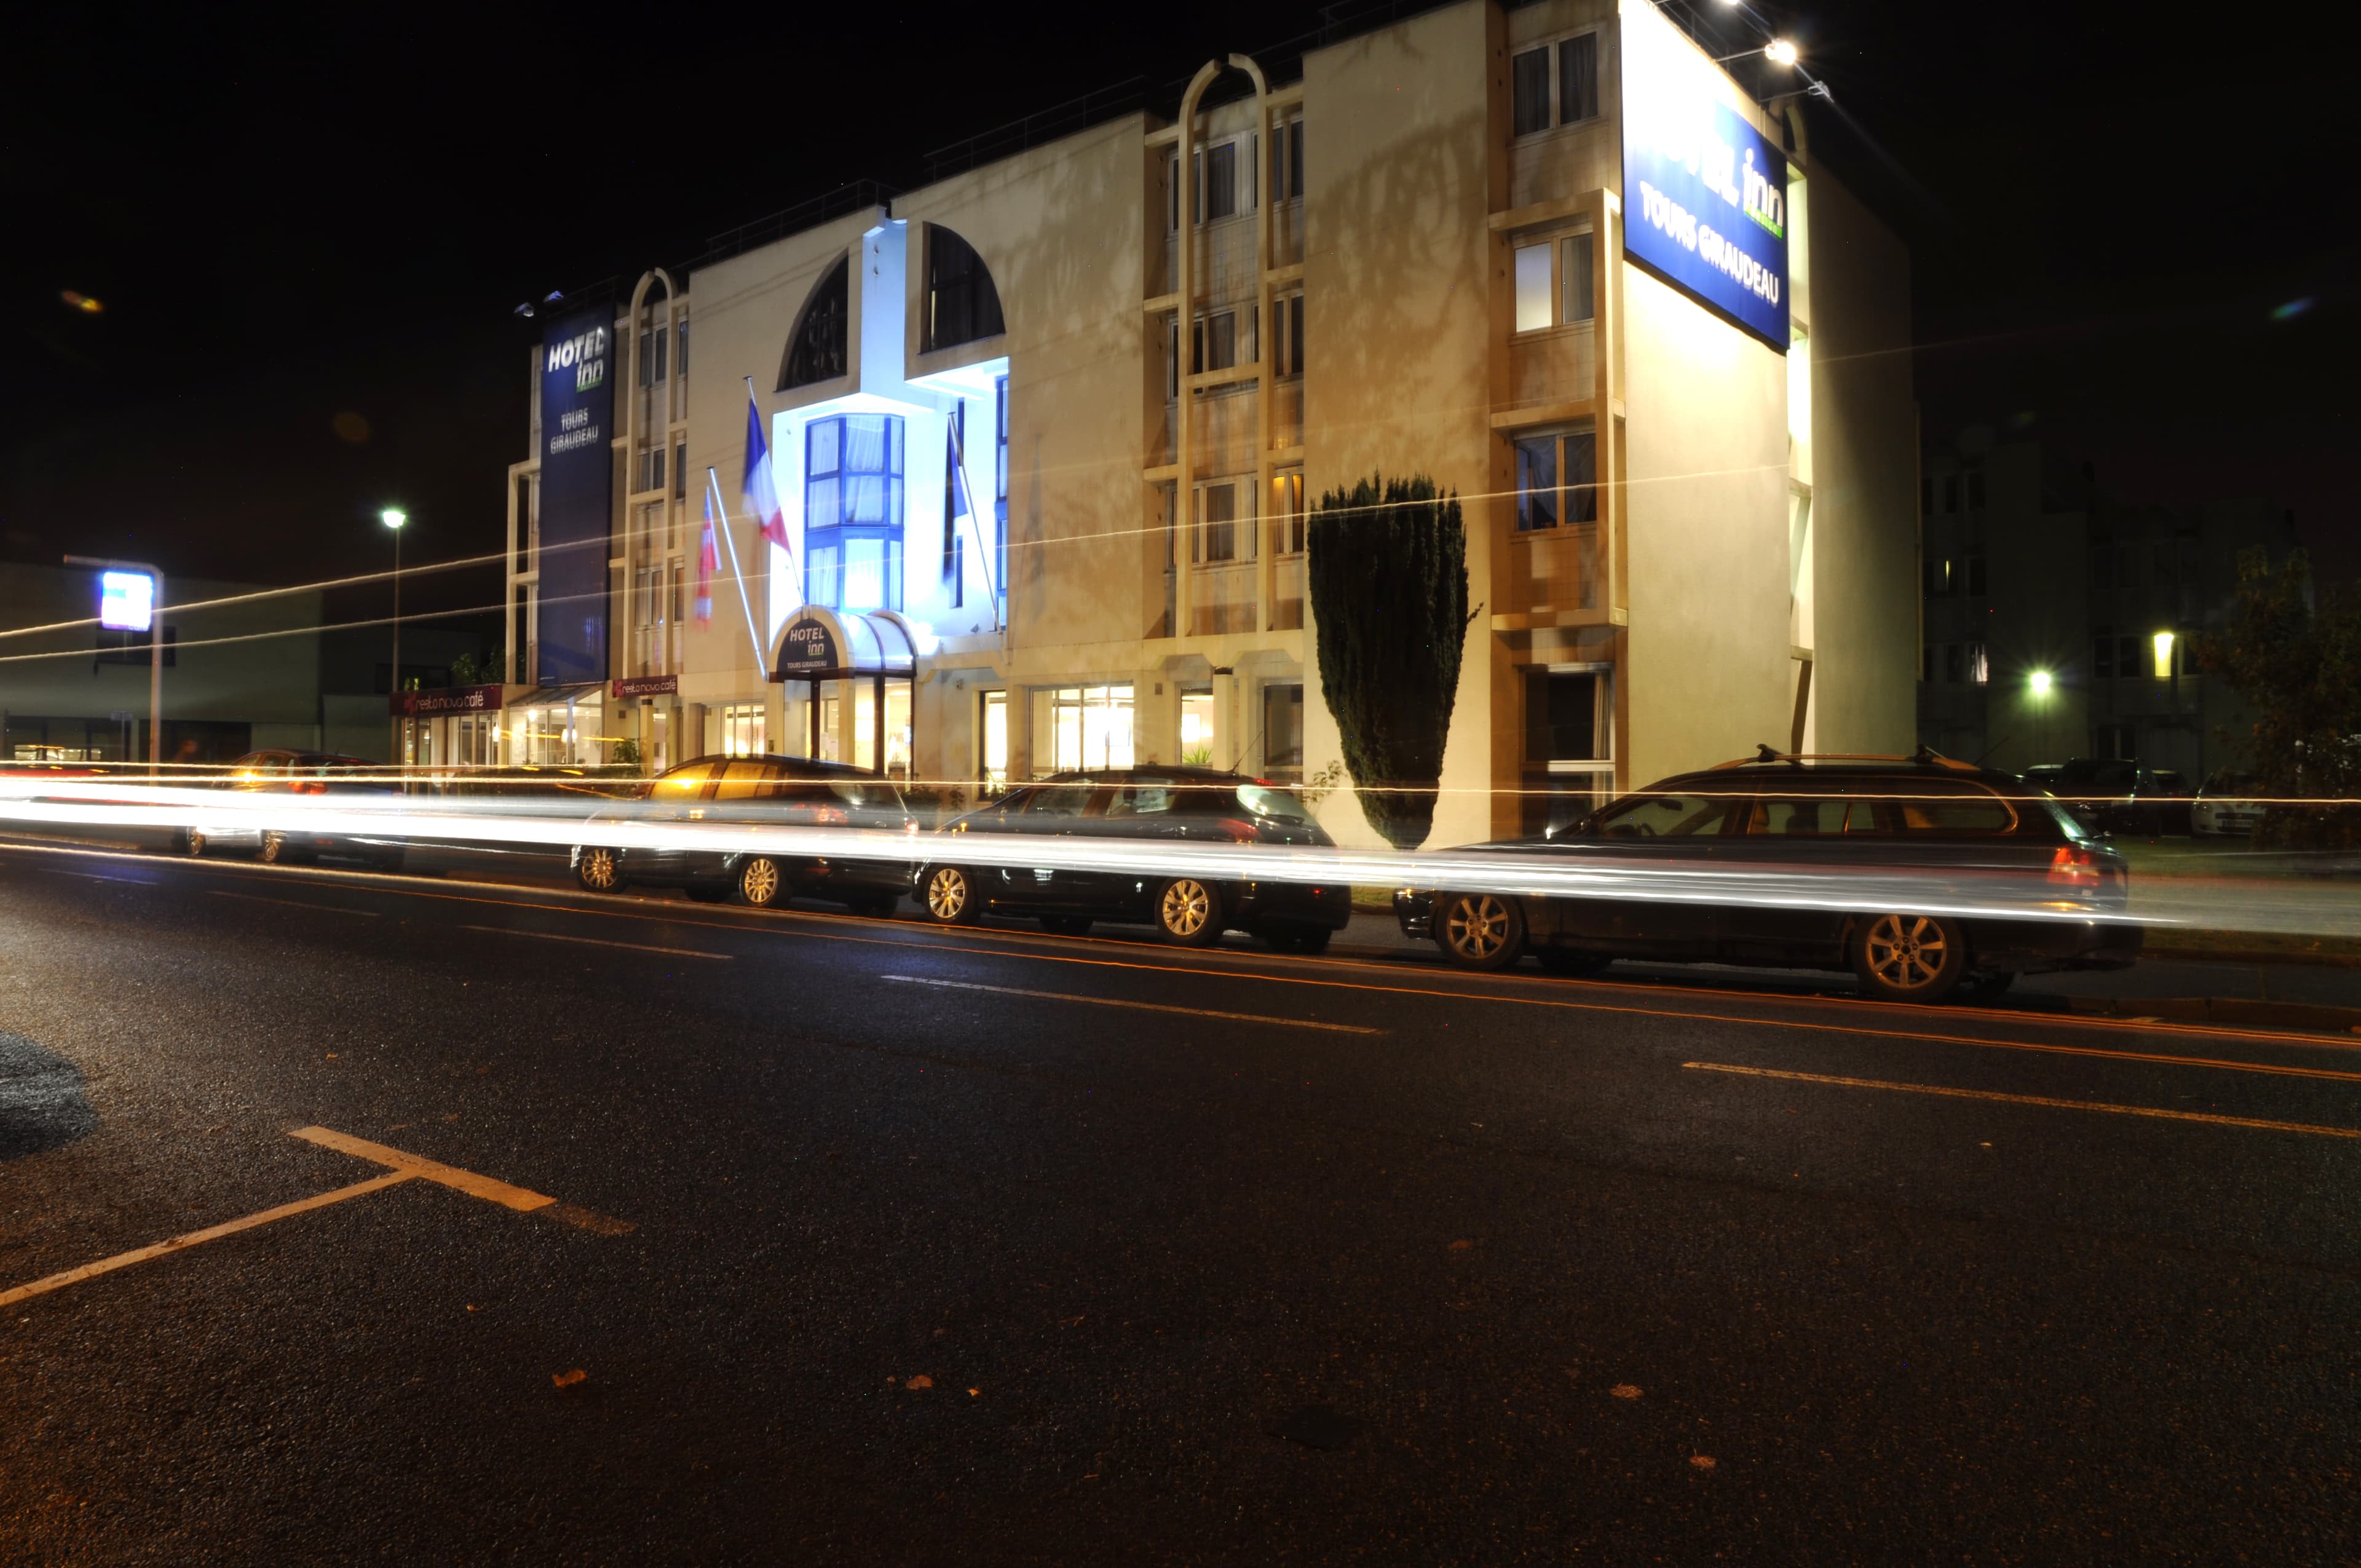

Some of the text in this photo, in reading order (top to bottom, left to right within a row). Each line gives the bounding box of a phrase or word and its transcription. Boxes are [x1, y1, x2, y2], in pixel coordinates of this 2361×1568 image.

[1742, 148, 1782, 228] inn
[1640, 180, 1779, 307] TOURS GIRAUDEAU
[548, 329, 604, 372] HOTEL
[577, 358, 603, 387] inn
[561, 408, 588, 430] TOURS
[550, 426, 598, 454] GIRAUDEAU
[790, 627, 824, 641] HOTEL
[808, 641, 824, 654] inn
[622, 683, 640, 693] resto
[661, 678, 676, 691] café
[416, 690, 483, 711] resto novo café
